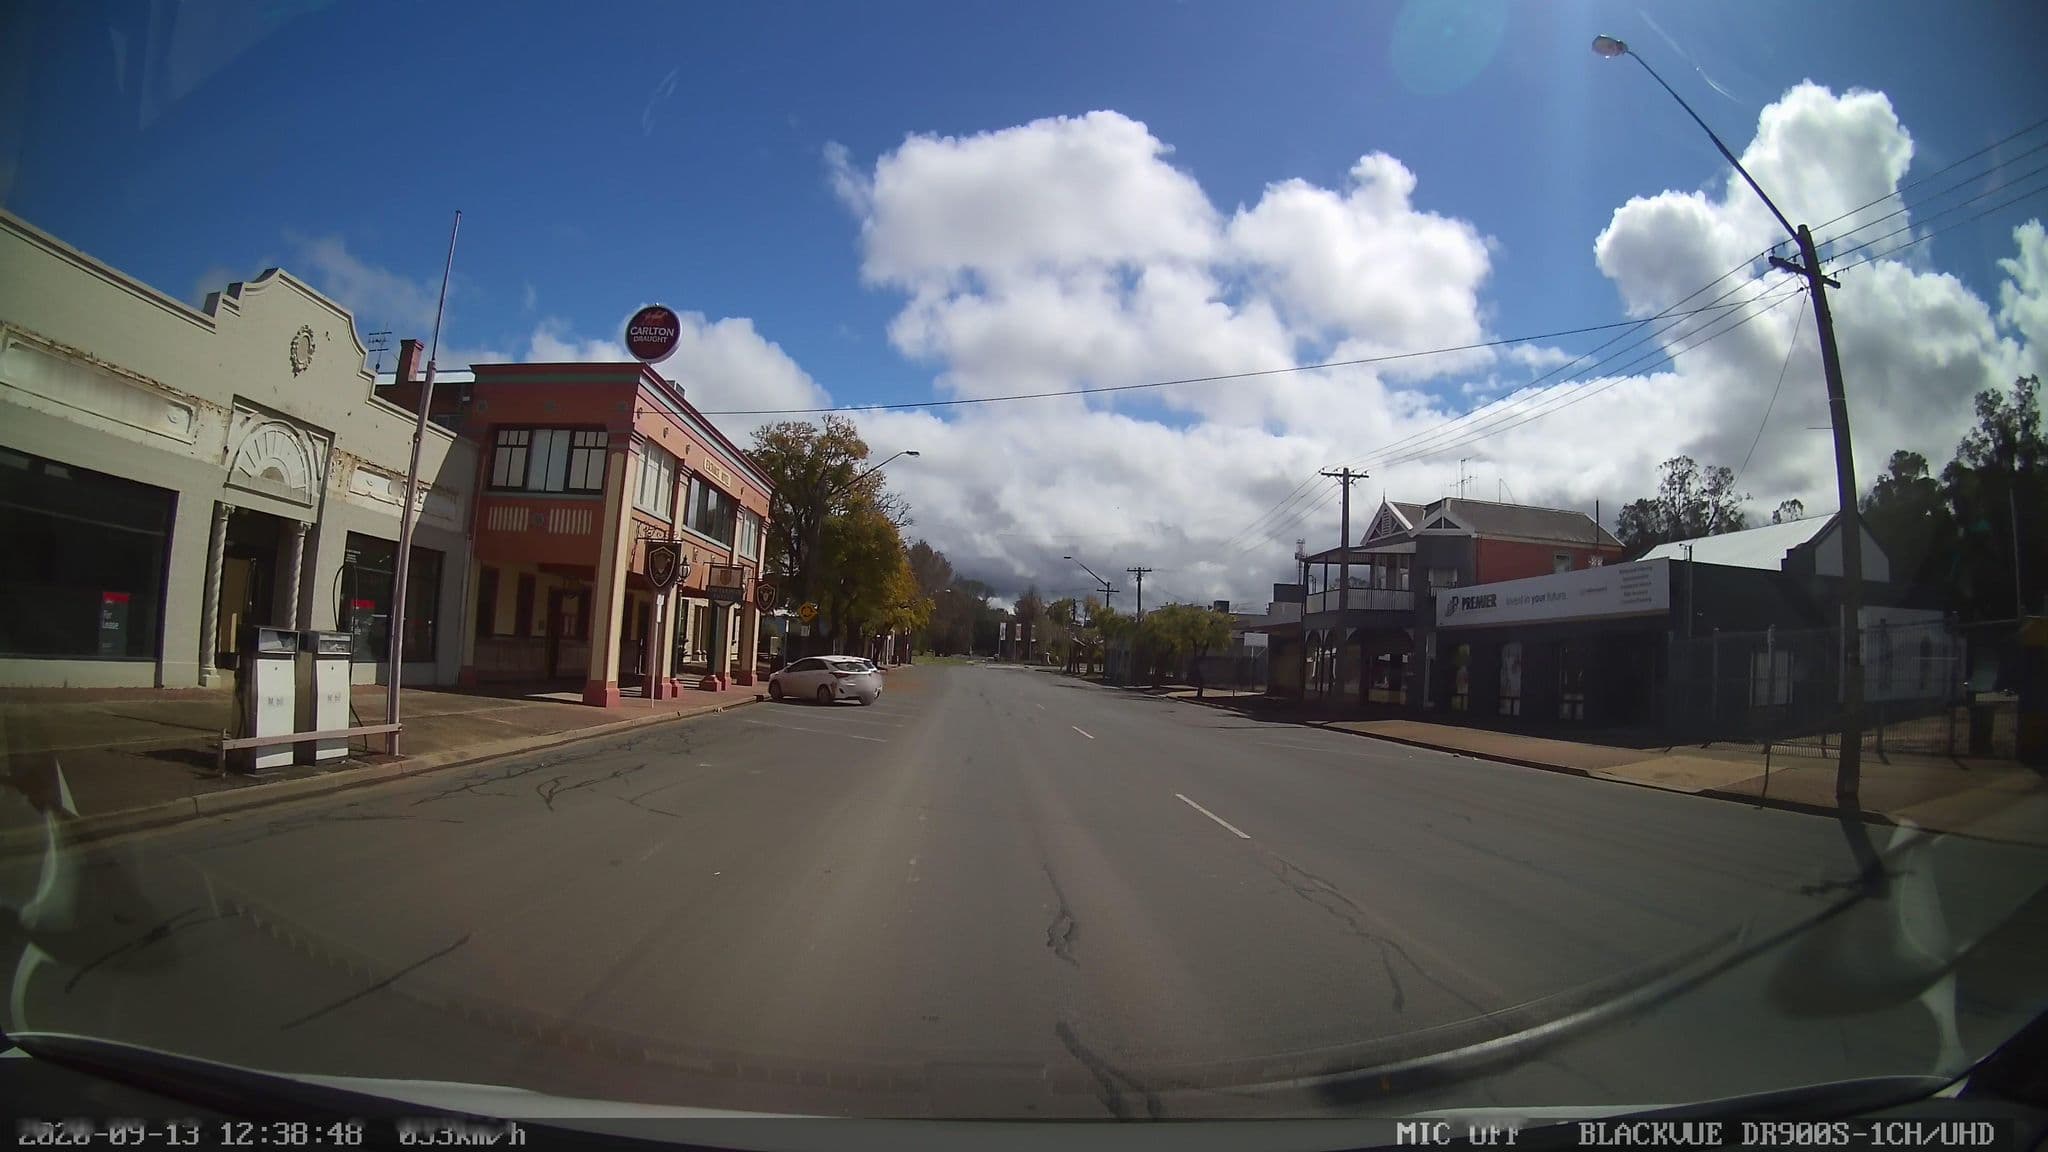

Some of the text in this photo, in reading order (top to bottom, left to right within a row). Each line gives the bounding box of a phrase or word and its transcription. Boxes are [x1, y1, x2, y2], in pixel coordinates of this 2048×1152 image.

[630, 326, 675, 337] CARLTON
[633, 335, 668, 344] DRAUGHT
[1461, 594, 1497, 610] PREMIER
